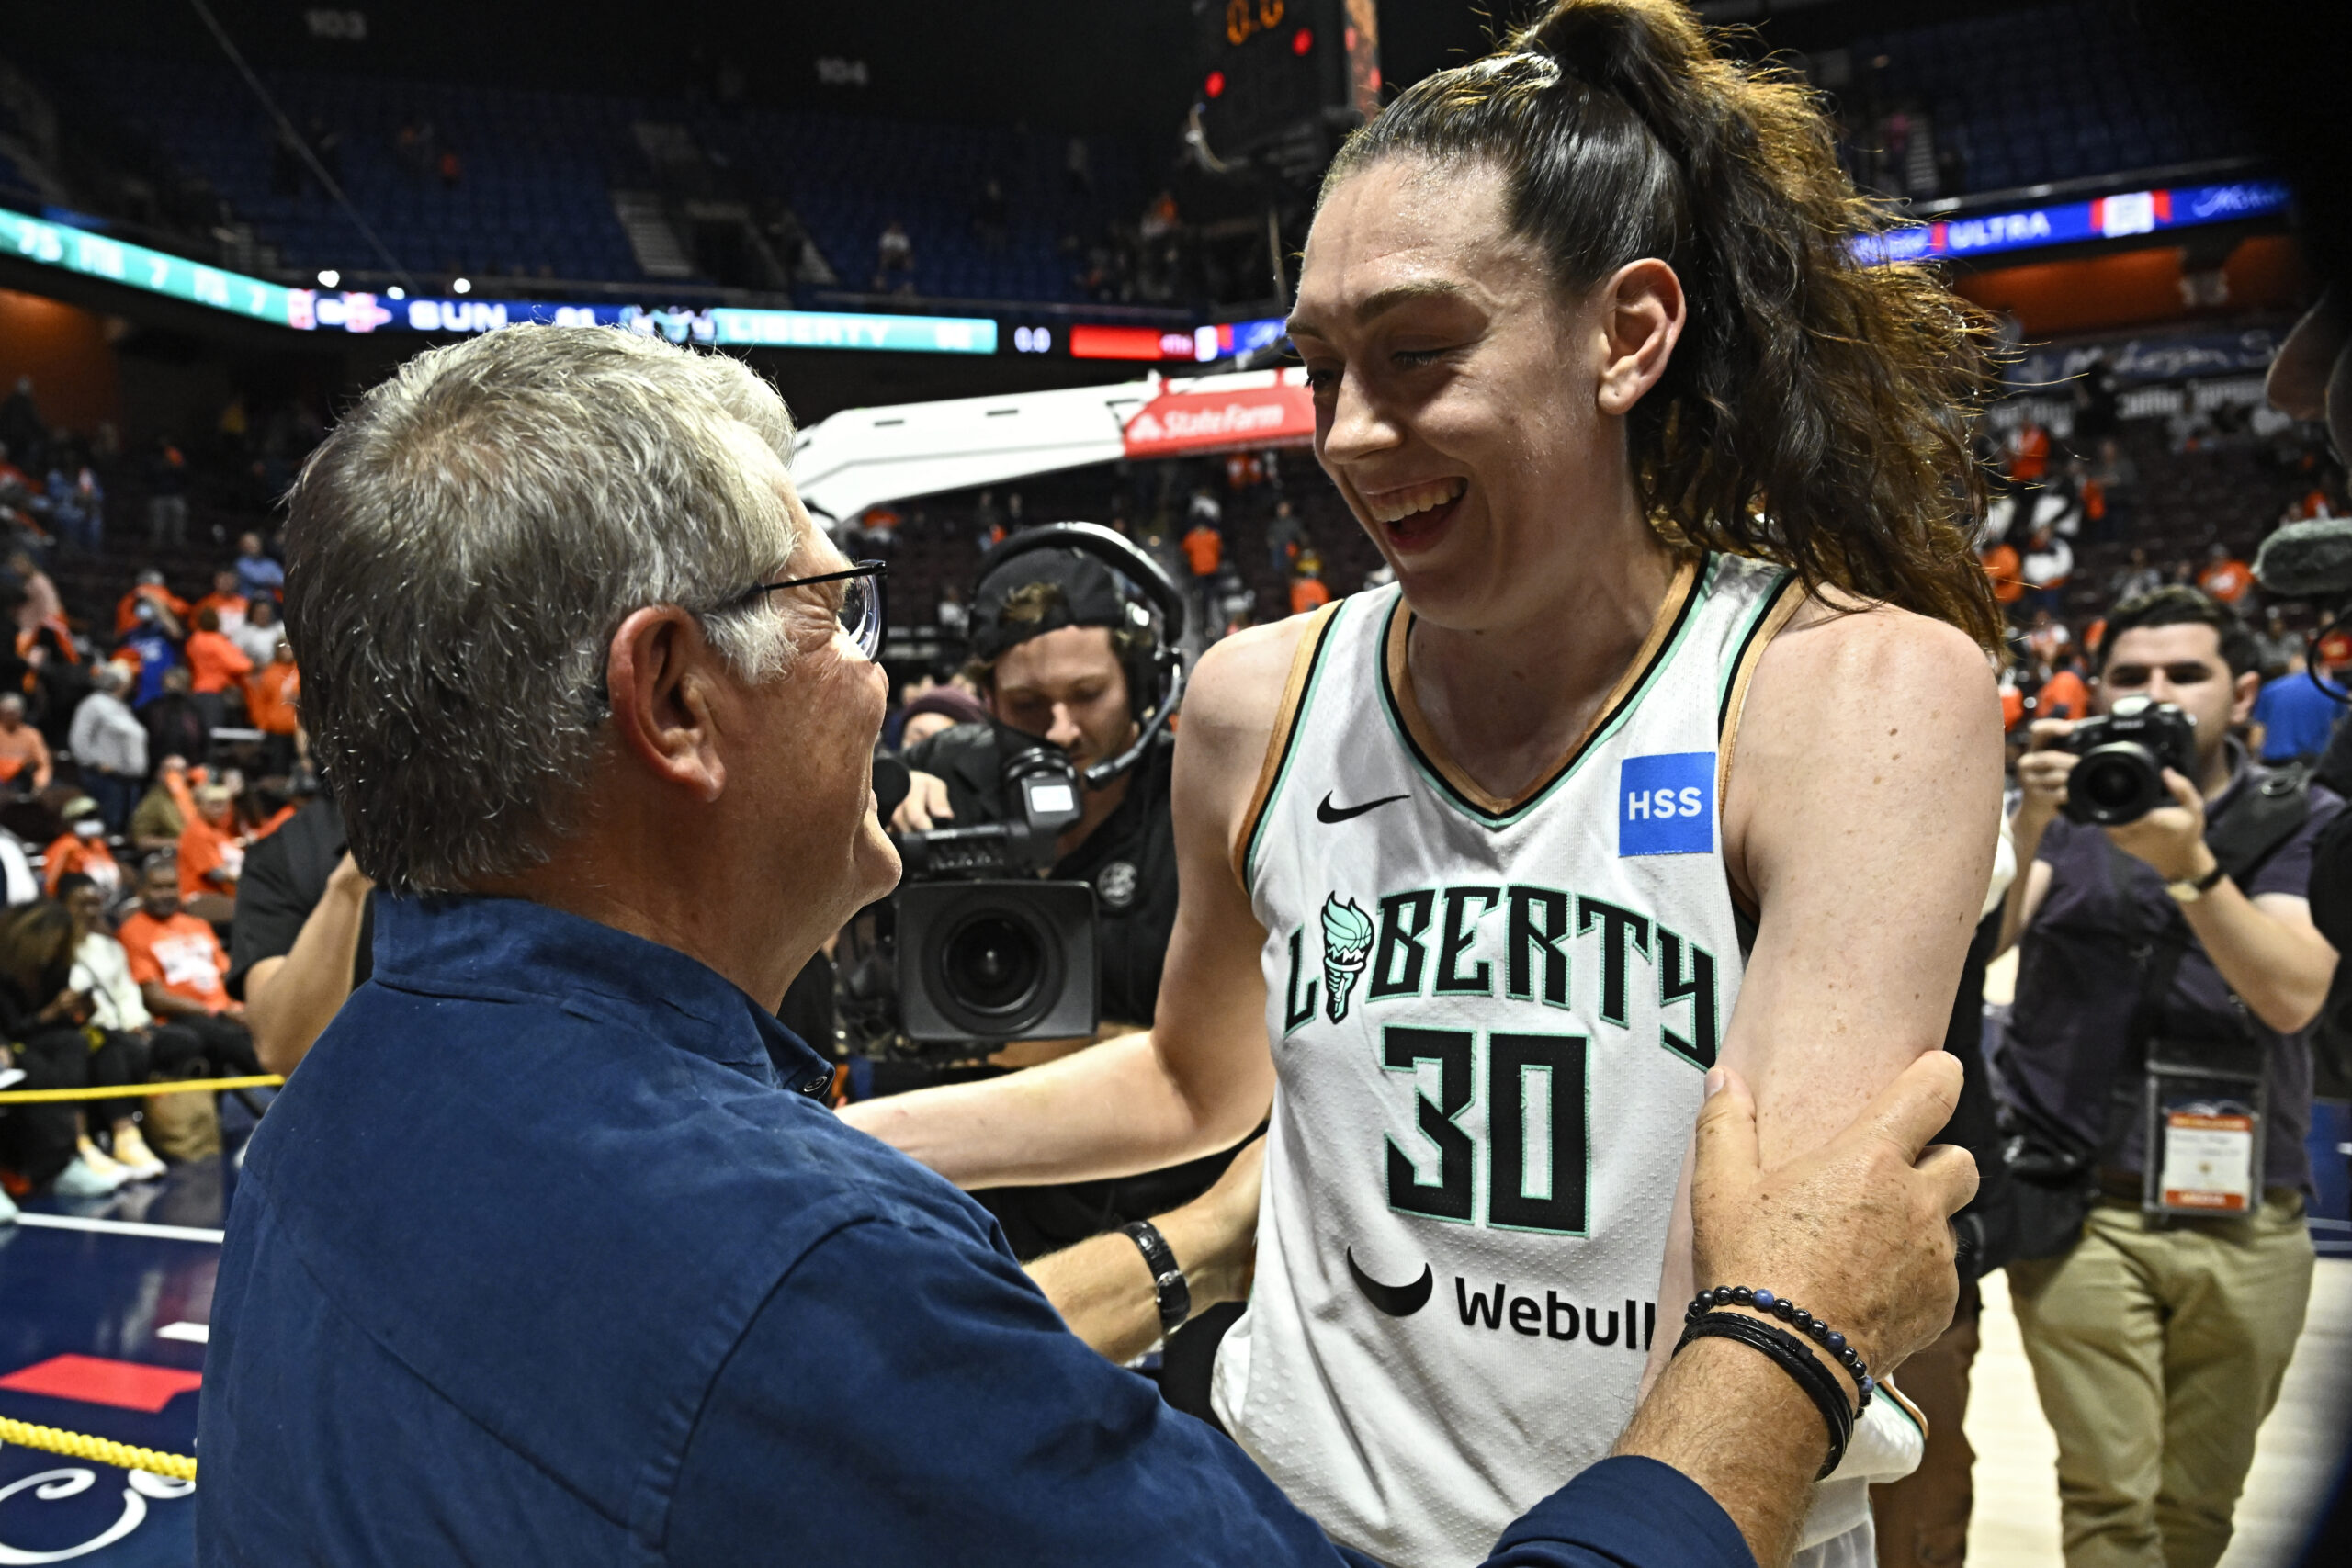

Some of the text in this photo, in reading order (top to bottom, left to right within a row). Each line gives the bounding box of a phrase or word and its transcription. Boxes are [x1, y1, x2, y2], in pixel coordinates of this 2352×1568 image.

[1948, 211, 2051, 250] ULTRA
[408, 299, 508, 332] SUN
[727, 313, 889, 348] LIBERTY
[1628, 786, 1702, 821] HSS
[1284, 883, 1720, 1073] LIBERTY
[1382, 1024, 1591, 1238] 30
[1454, 1276, 1656, 1351] Webull
